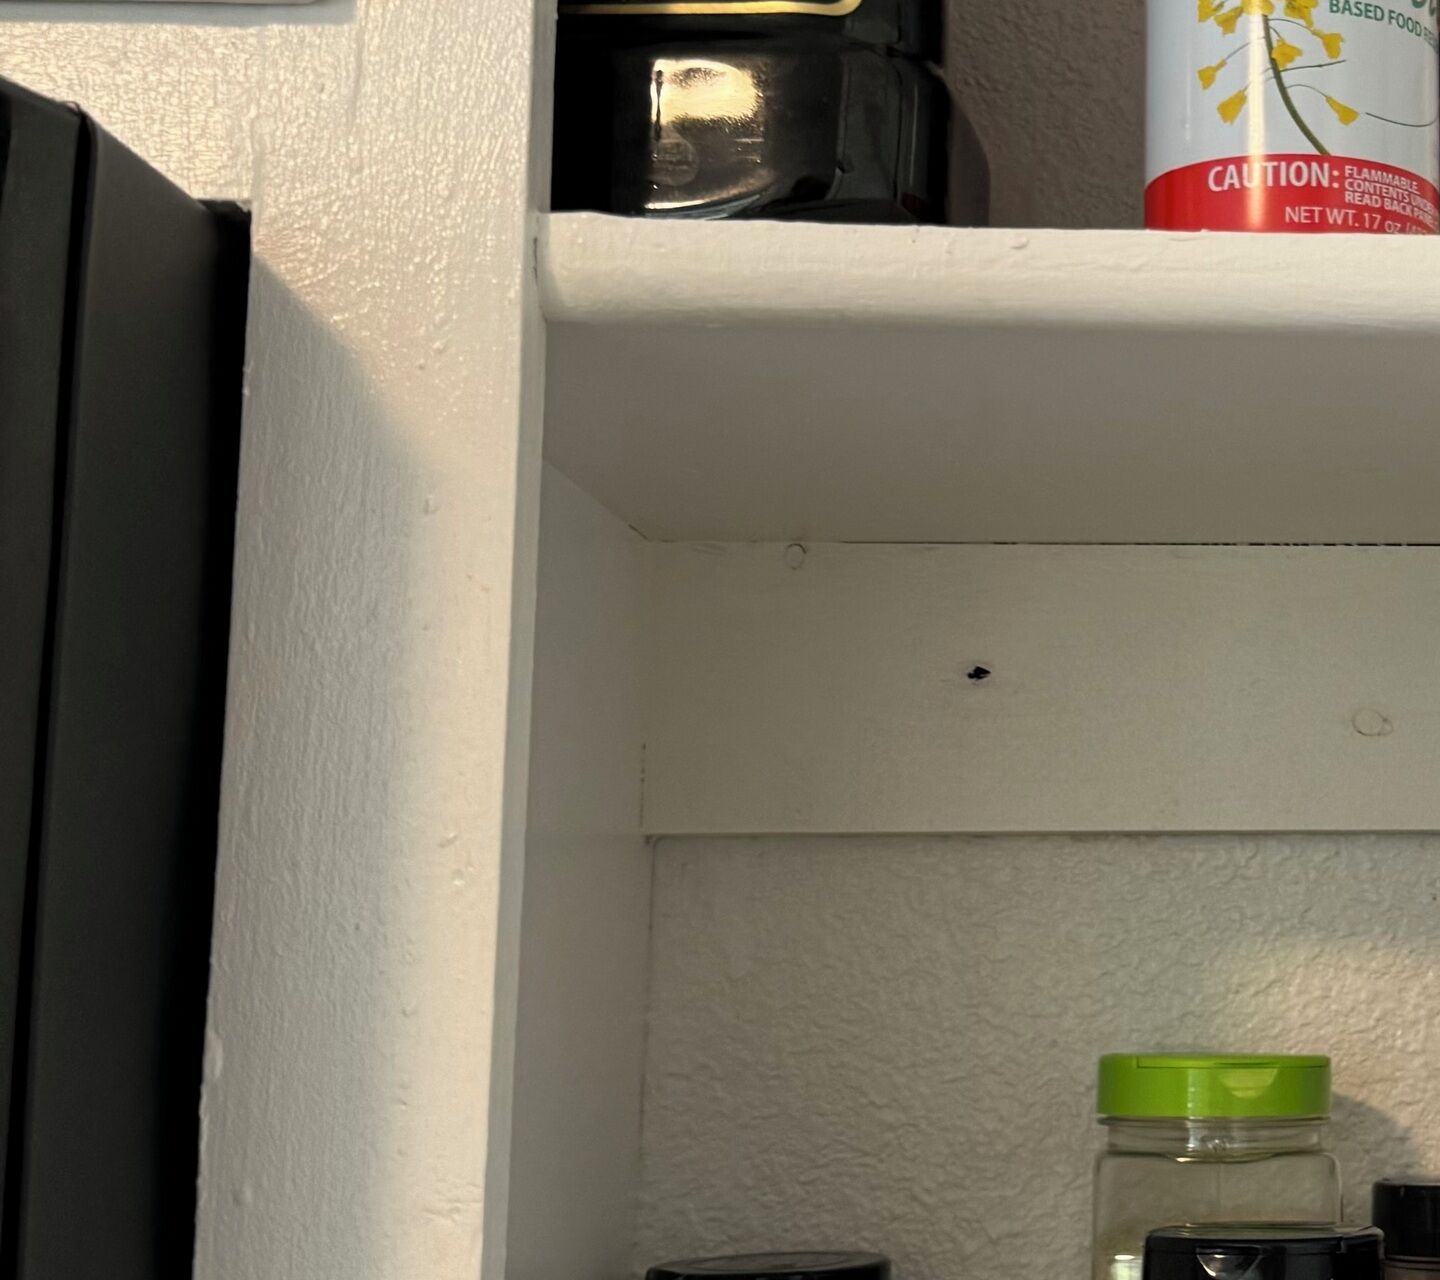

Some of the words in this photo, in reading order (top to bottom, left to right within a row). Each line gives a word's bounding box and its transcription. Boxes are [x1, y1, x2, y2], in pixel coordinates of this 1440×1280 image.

[1388, 10, 1422, 37] FOOD
[1207, 160, 1341, 193] CAUTION:
[1344, 191, 1381, 208] READ
[1285, 206, 1324, 224] NET
[1326, 208, 1360, 228] WT.
[1363, 213, 1382, 230] 17
